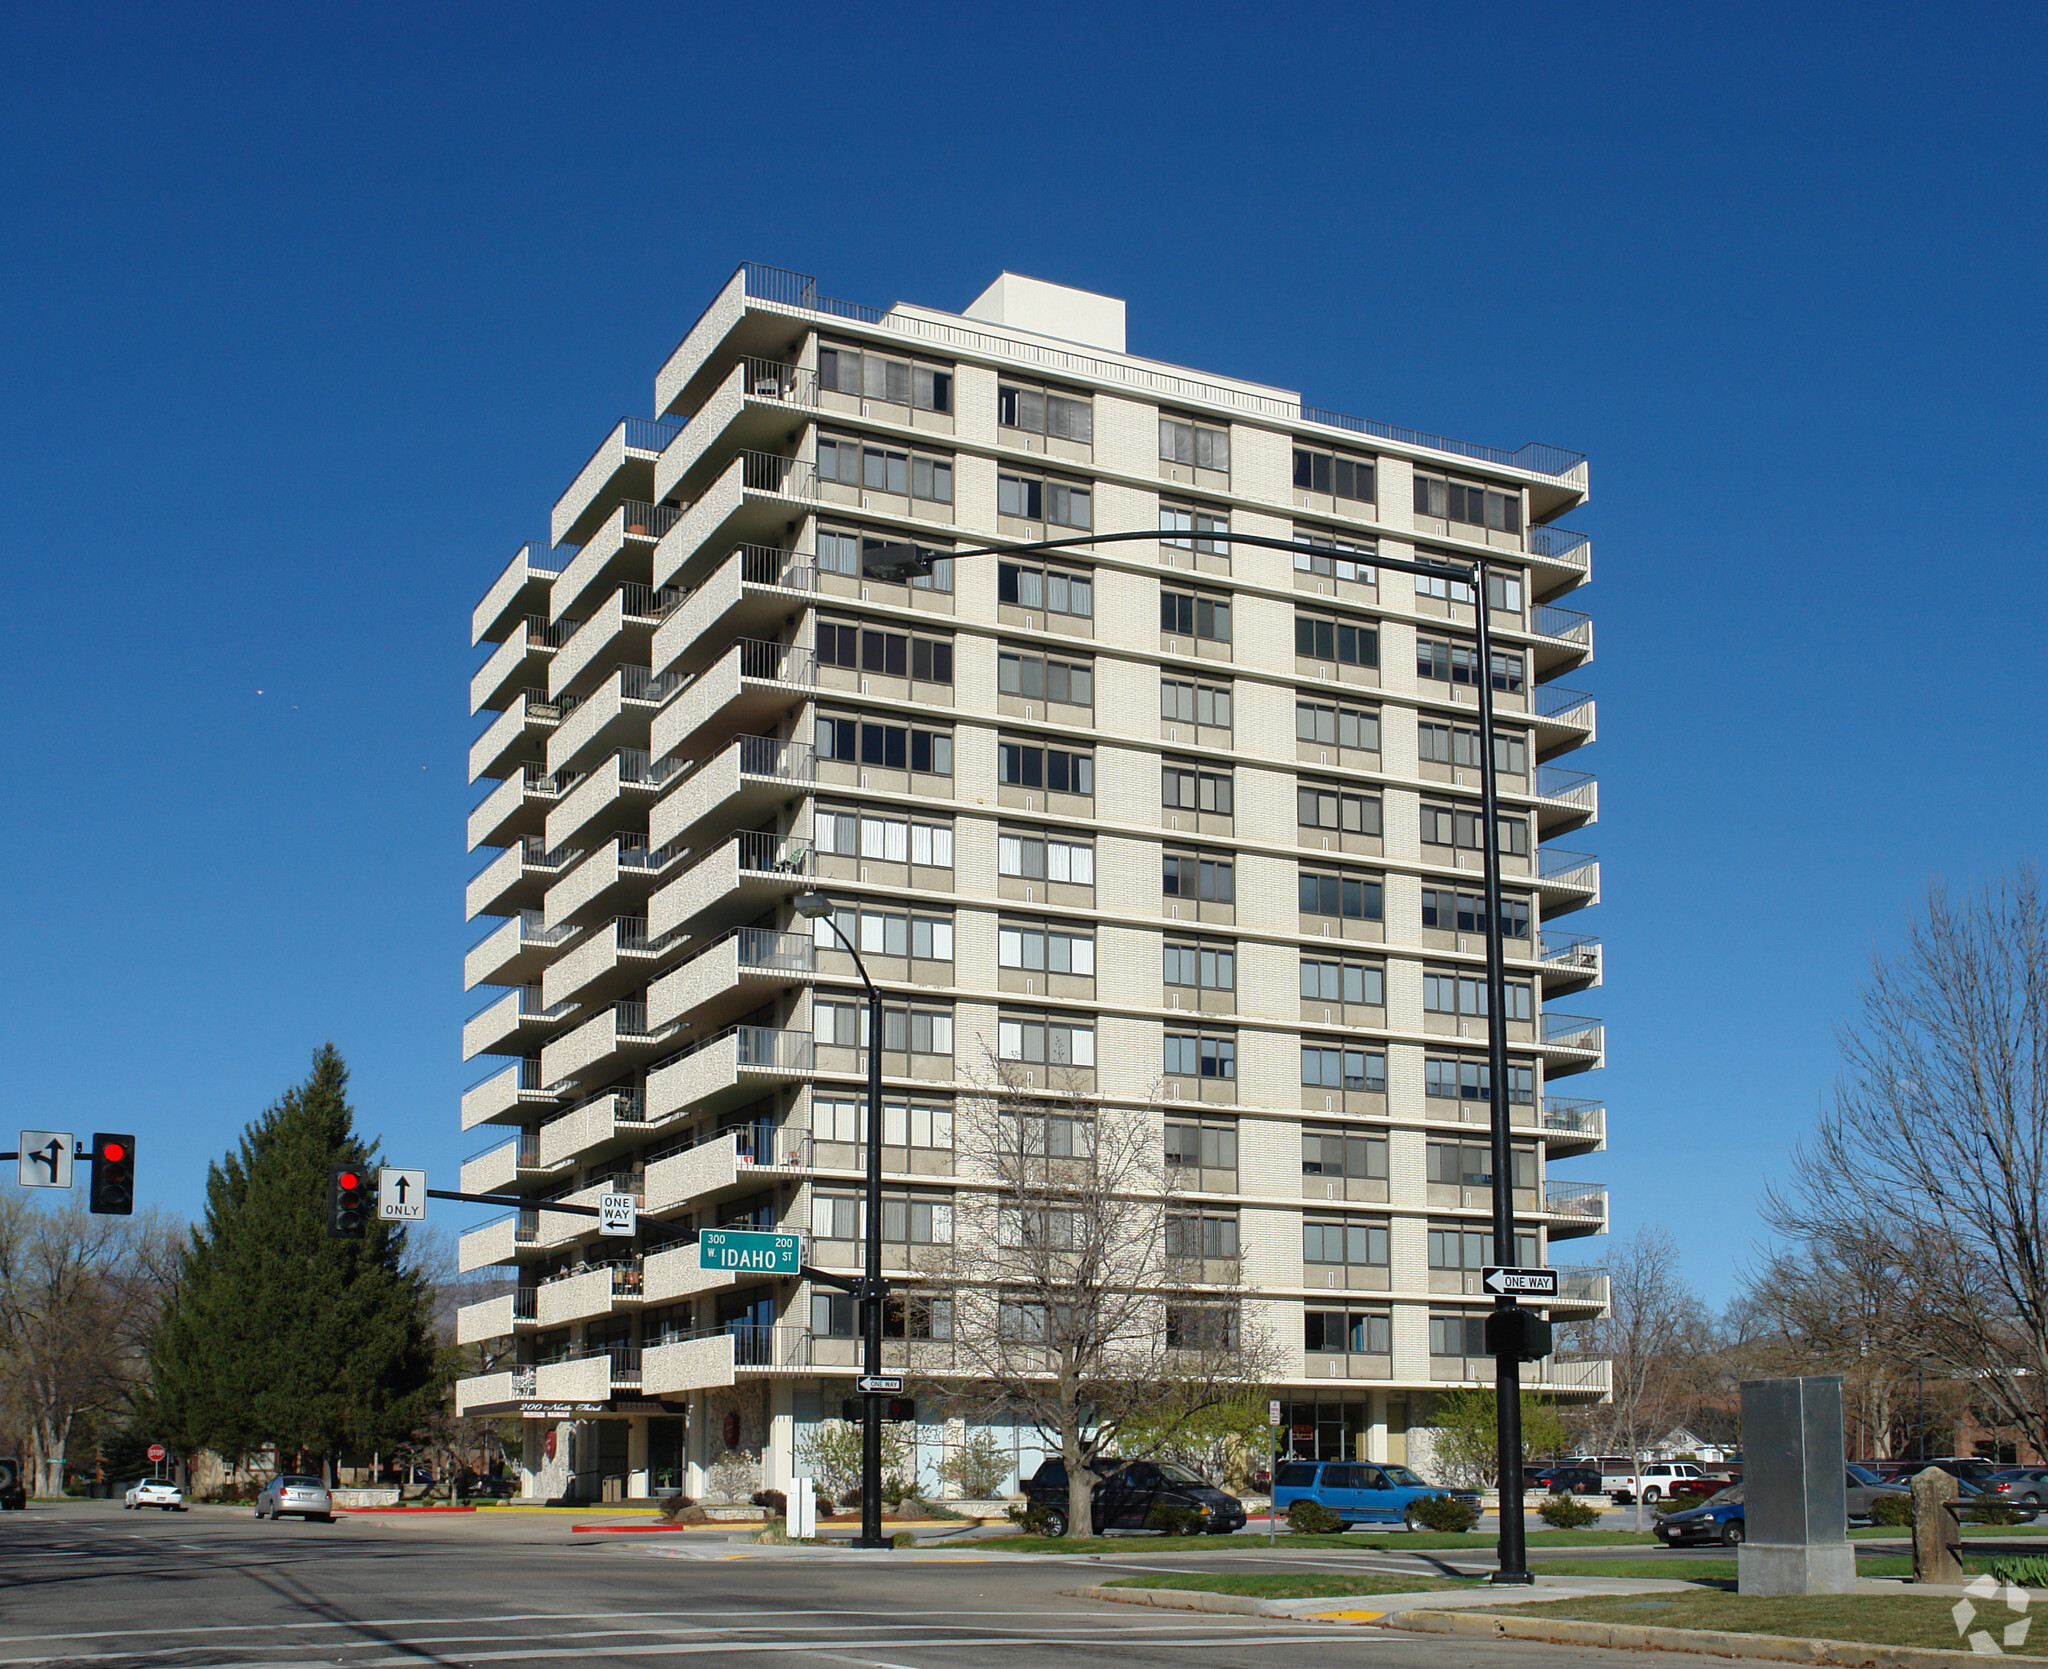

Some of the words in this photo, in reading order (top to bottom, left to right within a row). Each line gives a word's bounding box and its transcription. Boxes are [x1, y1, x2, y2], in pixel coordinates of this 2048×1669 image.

[604, 1197, 630, 1208] ONE
[385, 1204, 420, 1216] ONLY
[604, 1209, 630, 1219] WAY
[707, 1234, 726, 1244] 300
[775, 1238, 793, 1248] 200
[707, 1248, 717, 1258] W.
[721, 1248, 776, 1269] IDAHO
[782, 1252, 792, 1262] ST
[1504, 1276, 1526, 1287] ONE
[1528, 1277, 1550, 1288] WAY
[870, 1380, 884, 1388] ONE
[519, 1403, 543, 1411] 200
[543, 1403, 573, 1411] North
[575, 1403, 602, 1412] Third
[147, 1449, 165, 1457] STOP
